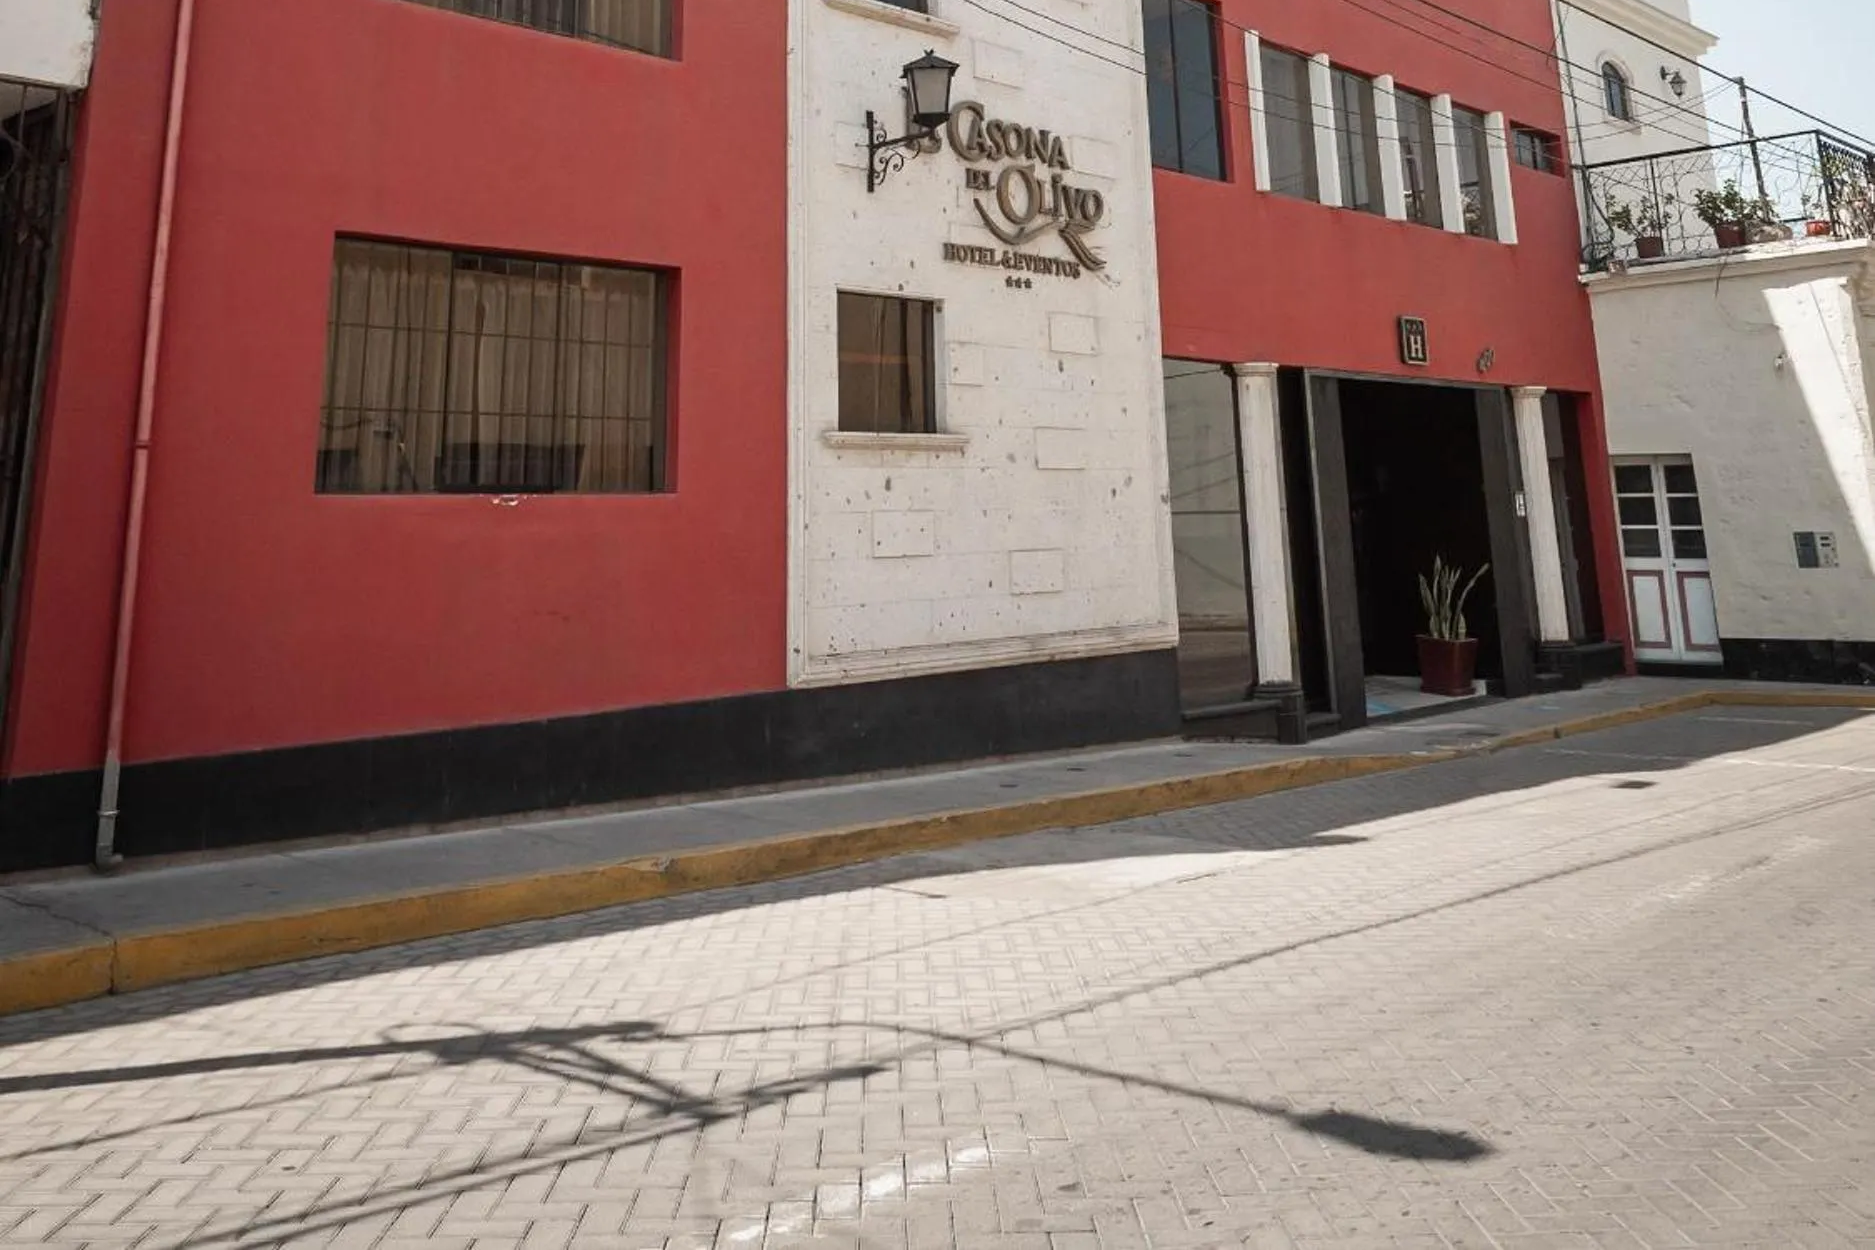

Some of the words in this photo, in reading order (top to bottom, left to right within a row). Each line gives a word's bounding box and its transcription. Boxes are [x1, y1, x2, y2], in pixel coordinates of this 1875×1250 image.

[946, 100, 1070, 170] CASONA
[943, 242, 1001, 267] HOTEL
[1013, 252, 1081, 280] EVENTOS
[1409, 334, 1424, 359] H
